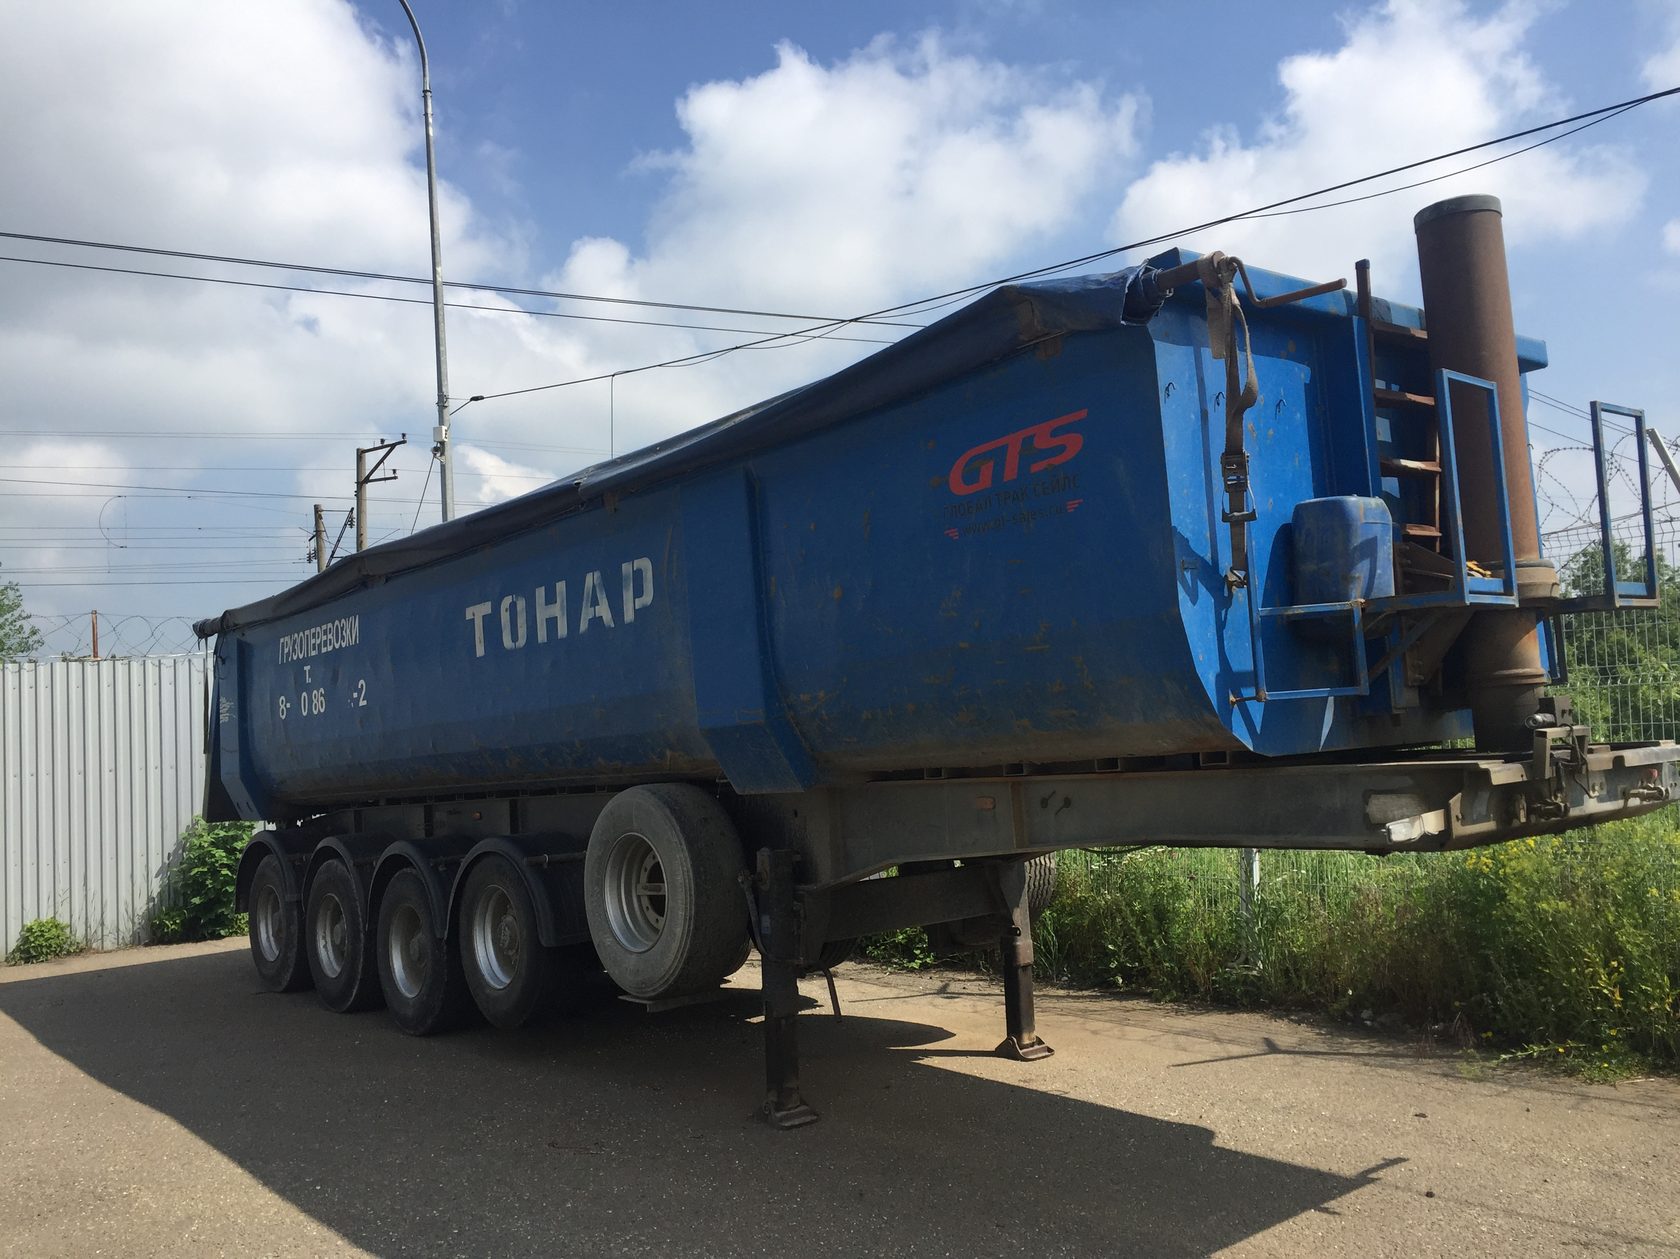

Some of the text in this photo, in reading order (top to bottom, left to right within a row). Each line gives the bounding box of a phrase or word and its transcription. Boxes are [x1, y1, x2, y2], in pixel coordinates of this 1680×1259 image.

[949, 408, 1088, 496] GTS
[278, 614, 360, 665] ГРУЗОПЕРЕВОЗКИ
[465, 557, 654, 658] ТОНАР
